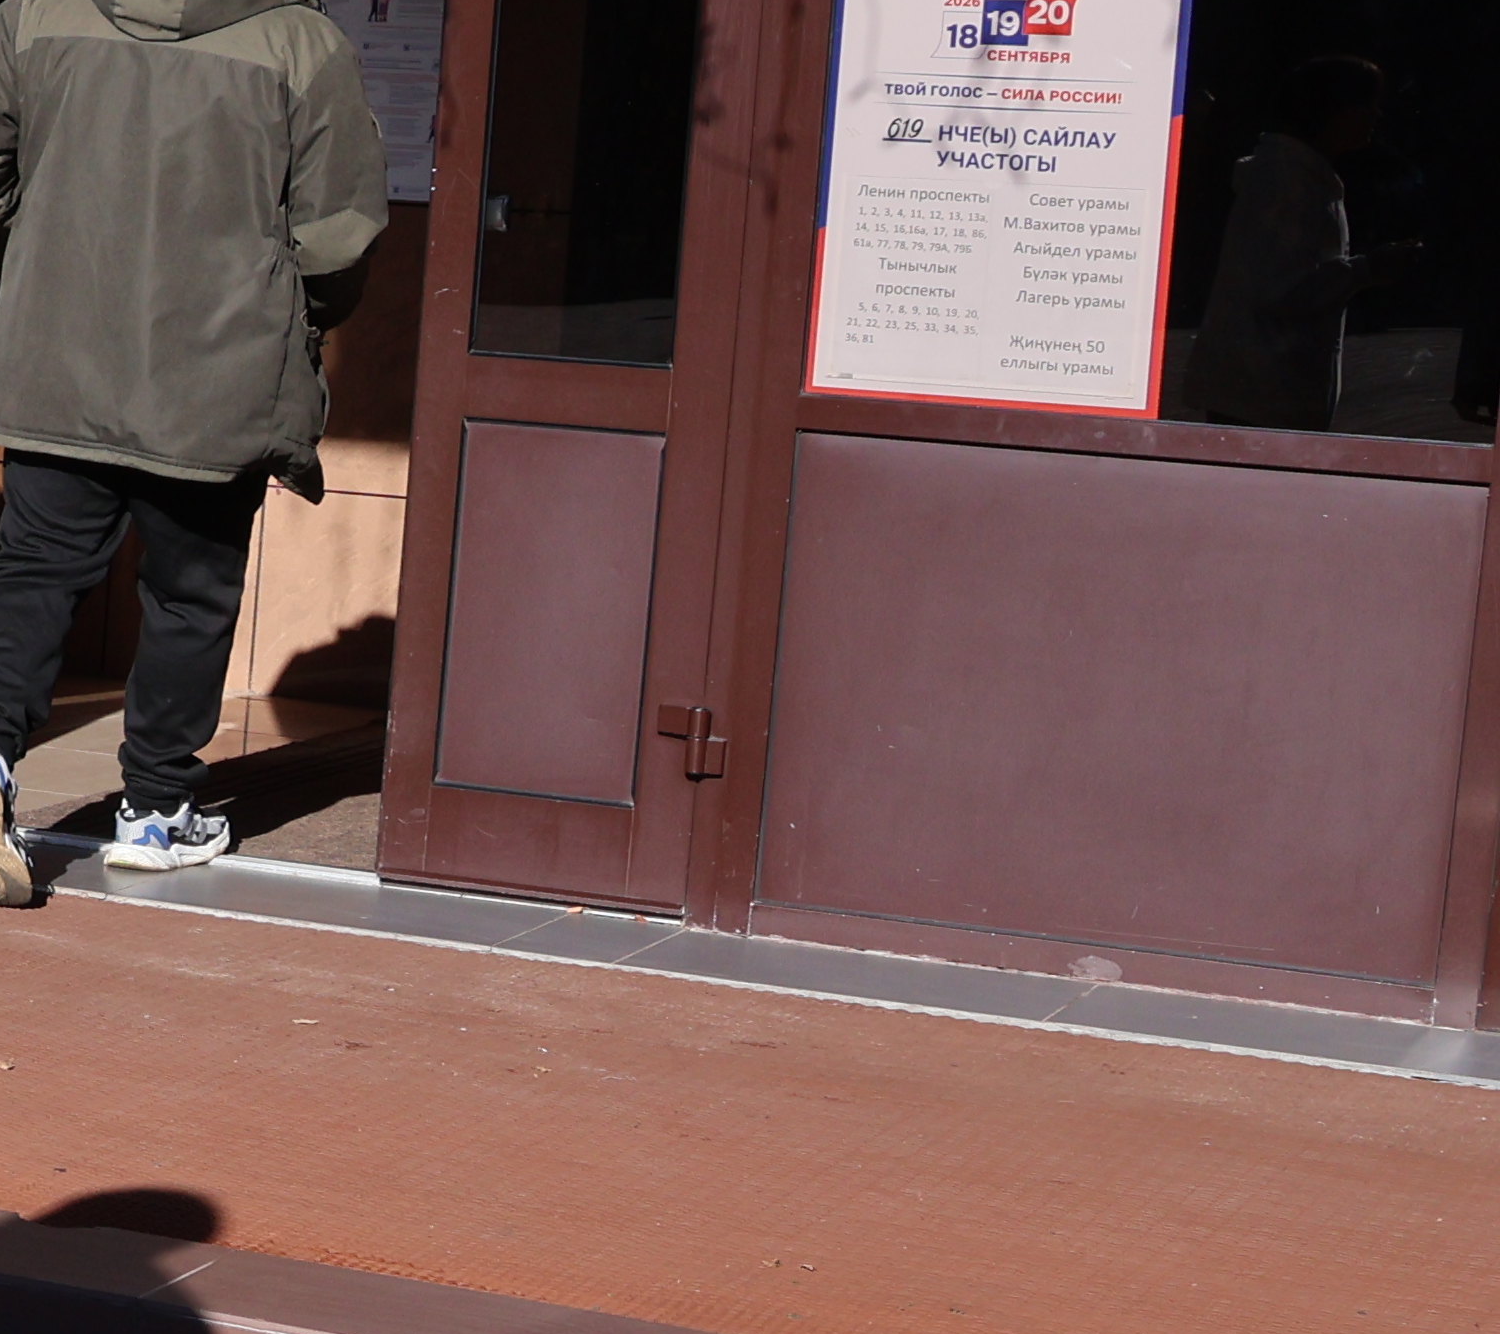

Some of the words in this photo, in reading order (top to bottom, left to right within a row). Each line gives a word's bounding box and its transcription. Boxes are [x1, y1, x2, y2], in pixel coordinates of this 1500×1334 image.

[1027, 0, 1070, 25] 20
[986, 10, 1020, 37] 19
[946, 24, 978, 48] 18
[987, 49, 1071, 64] СЕНТЯБРЯ
[884, 82, 926, 96] ТВОЙ
[930, 85, 983, 98] ГОЛОС
[1001, 88, 1045, 101] СИЛА
[1049, 90, 1122, 104] РОССИИ!
[887, 118, 924, 139] 619
[939, 125, 1017, 148] НЧЕ(Ы)
[1023, 127, 1116, 149] САЙЛАУ
[936, 150, 1057, 172] УЧАСТОГЫ
[857, 184, 905, 199] Ленин
[909, 189, 991, 204] проспекты
[1029, 193, 1074, 208] Совет
[1077, 198, 1129, 211] урамы
[871, 207, 880, 217] 2,
[1003, 216, 1085, 233] М.Вахитов
[1089, 223, 1141, 236] урамы
[1013, 241, 1080, 259] Агыйдел
[1085, 247, 1137, 261] урамы
[878, 257, 957, 274] Тынычлык
[1071, 272, 1123, 285] урамы
[875, 283, 956, 298] проспекты
[1015, 290, 1070, 307] Лагерь
[1074, 296, 1125, 309] урамы
[1086, 340, 1105, 353] 50
[1000, 358, 1058, 371] еллыгы
[1062, 362, 1114, 375] урамы
